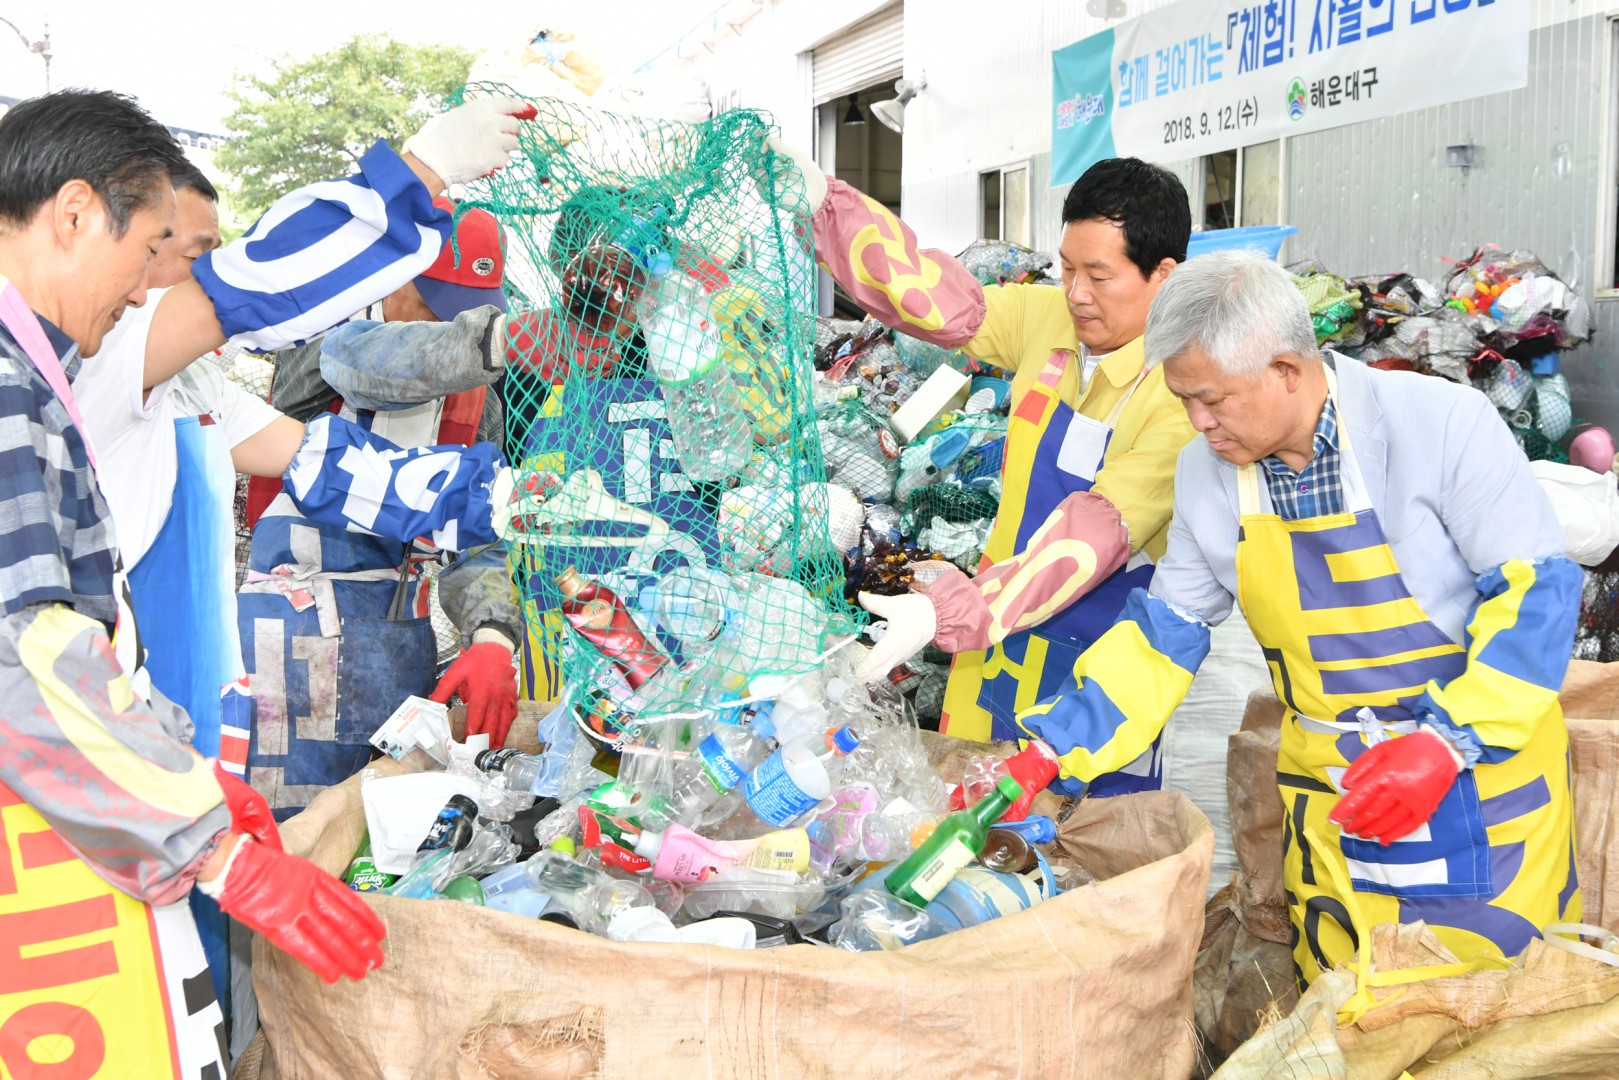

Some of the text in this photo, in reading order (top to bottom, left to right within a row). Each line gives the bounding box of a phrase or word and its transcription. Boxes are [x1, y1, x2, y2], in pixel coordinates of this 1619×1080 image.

[1119, 54, 1149, 108] 함께
[1155, 33, 1224, 97] 걸어가는
[1310, 67, 1379, 109] 해운대구
[1164, 116, 1195, 144] 2018.
[1200, 112, 1211, 136] 9.
[619, 851, 630, 862] THE
